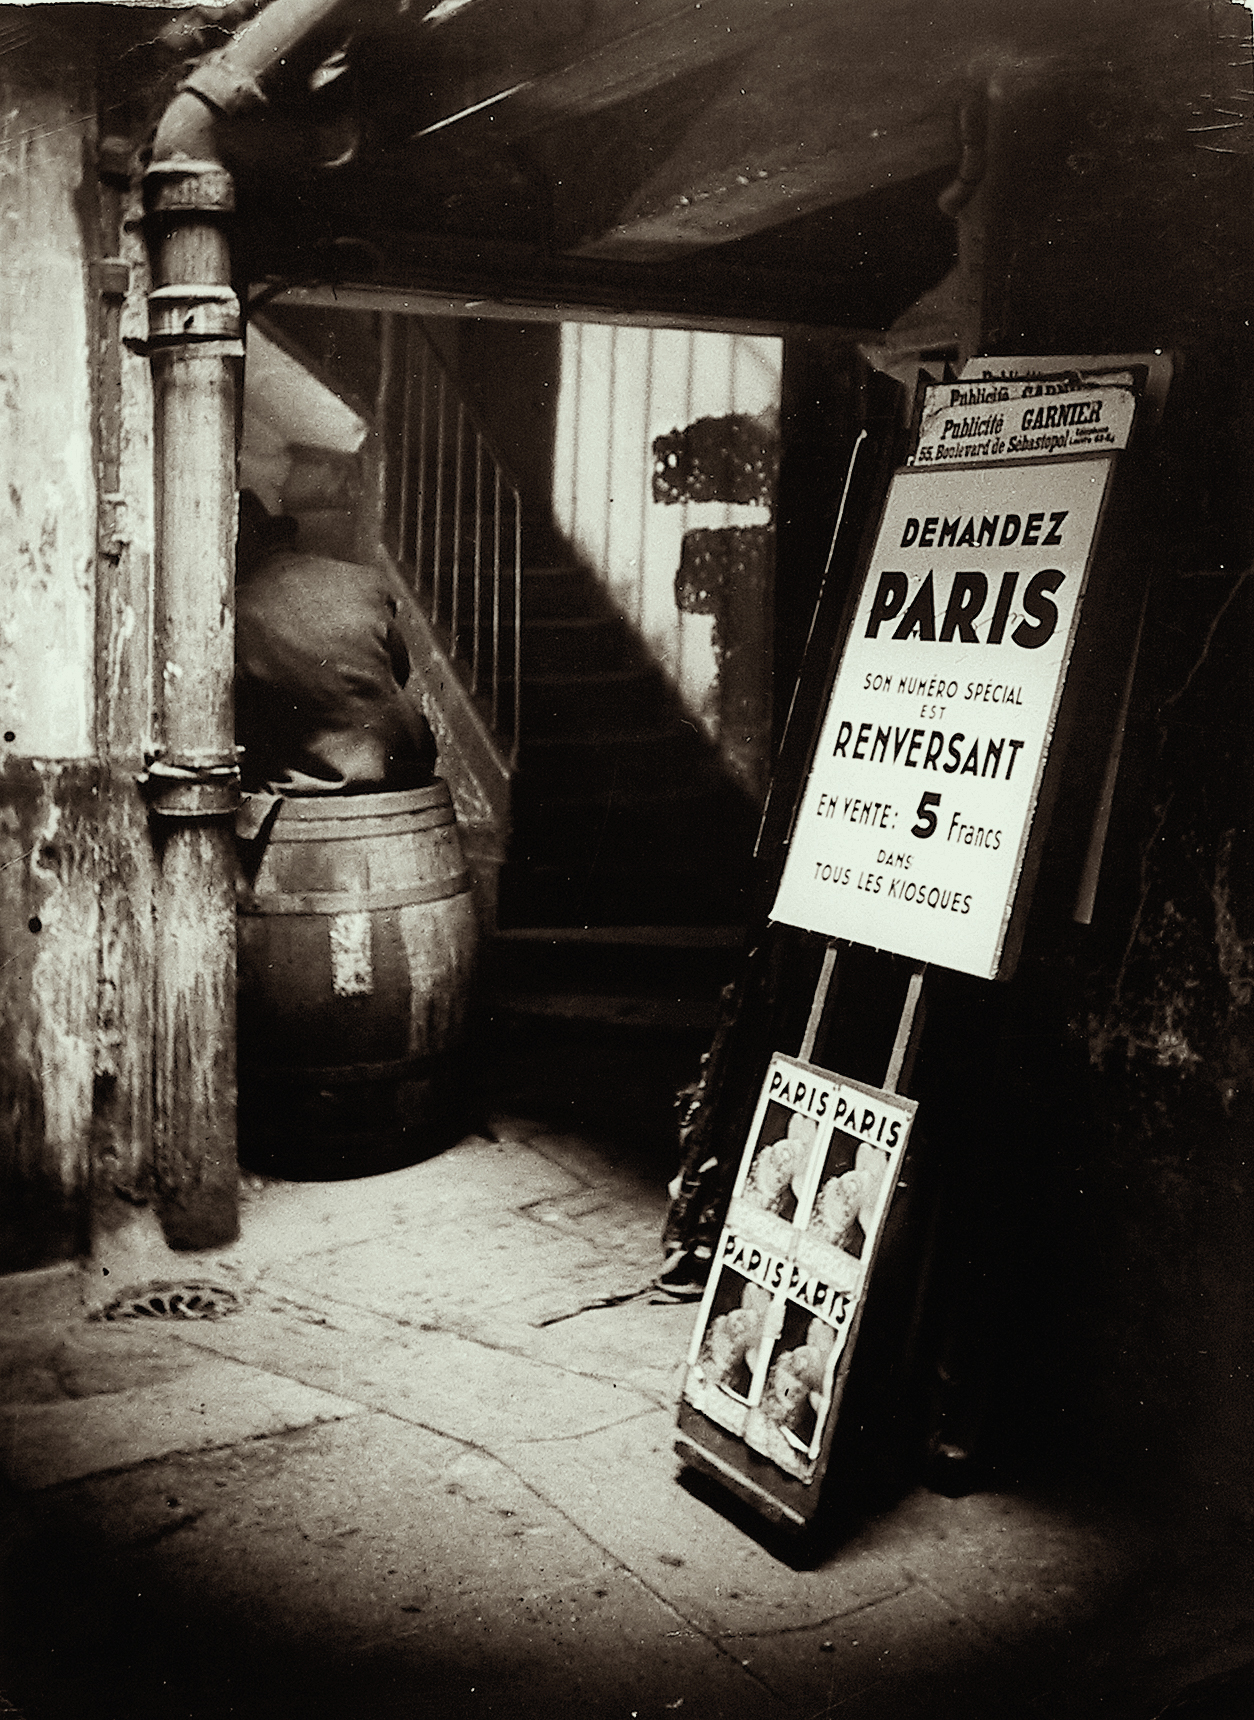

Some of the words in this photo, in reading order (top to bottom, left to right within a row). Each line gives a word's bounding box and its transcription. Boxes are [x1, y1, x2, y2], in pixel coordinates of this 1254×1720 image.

[941, 413, 1004, 440] Publicité
[1021, 400, 1102, 431] GARNIER
[936, 439, 992, 460] Boulevard
[992, 437, 1006, 454] de
[900, 510, 1069, 548] DEMANDEZ
[864, 568, 1066, 649] PARIS
[863, 673, 892, 693] SON
[897, 674, 958, 698] NUMÉRO
[964, 680, 1023, 706] SPÉCIAL
[920, 705, 947, 720] EST
[832, 721, 1025, 781] RENVERSANT
[817, 793, 838, 820] EN
[843, 797, 899, 830] VENTE:
[910, 791, 942, 839] 5
[947, 812, 1002, 850] Francs
[876, 849, 914, 870] DANS
[814, 861, 851, 886] TOUS
[857, 871, 882, 893] LES
[887, 879, 973, 915] KIOSQUES
[769, 1071, 830, 1117] PARIS
[834, 1098, 902, 1148] PARIS
[723, 1234, 785, 1288] PARIS
[789, 1266, 850, 1324] PARIS
